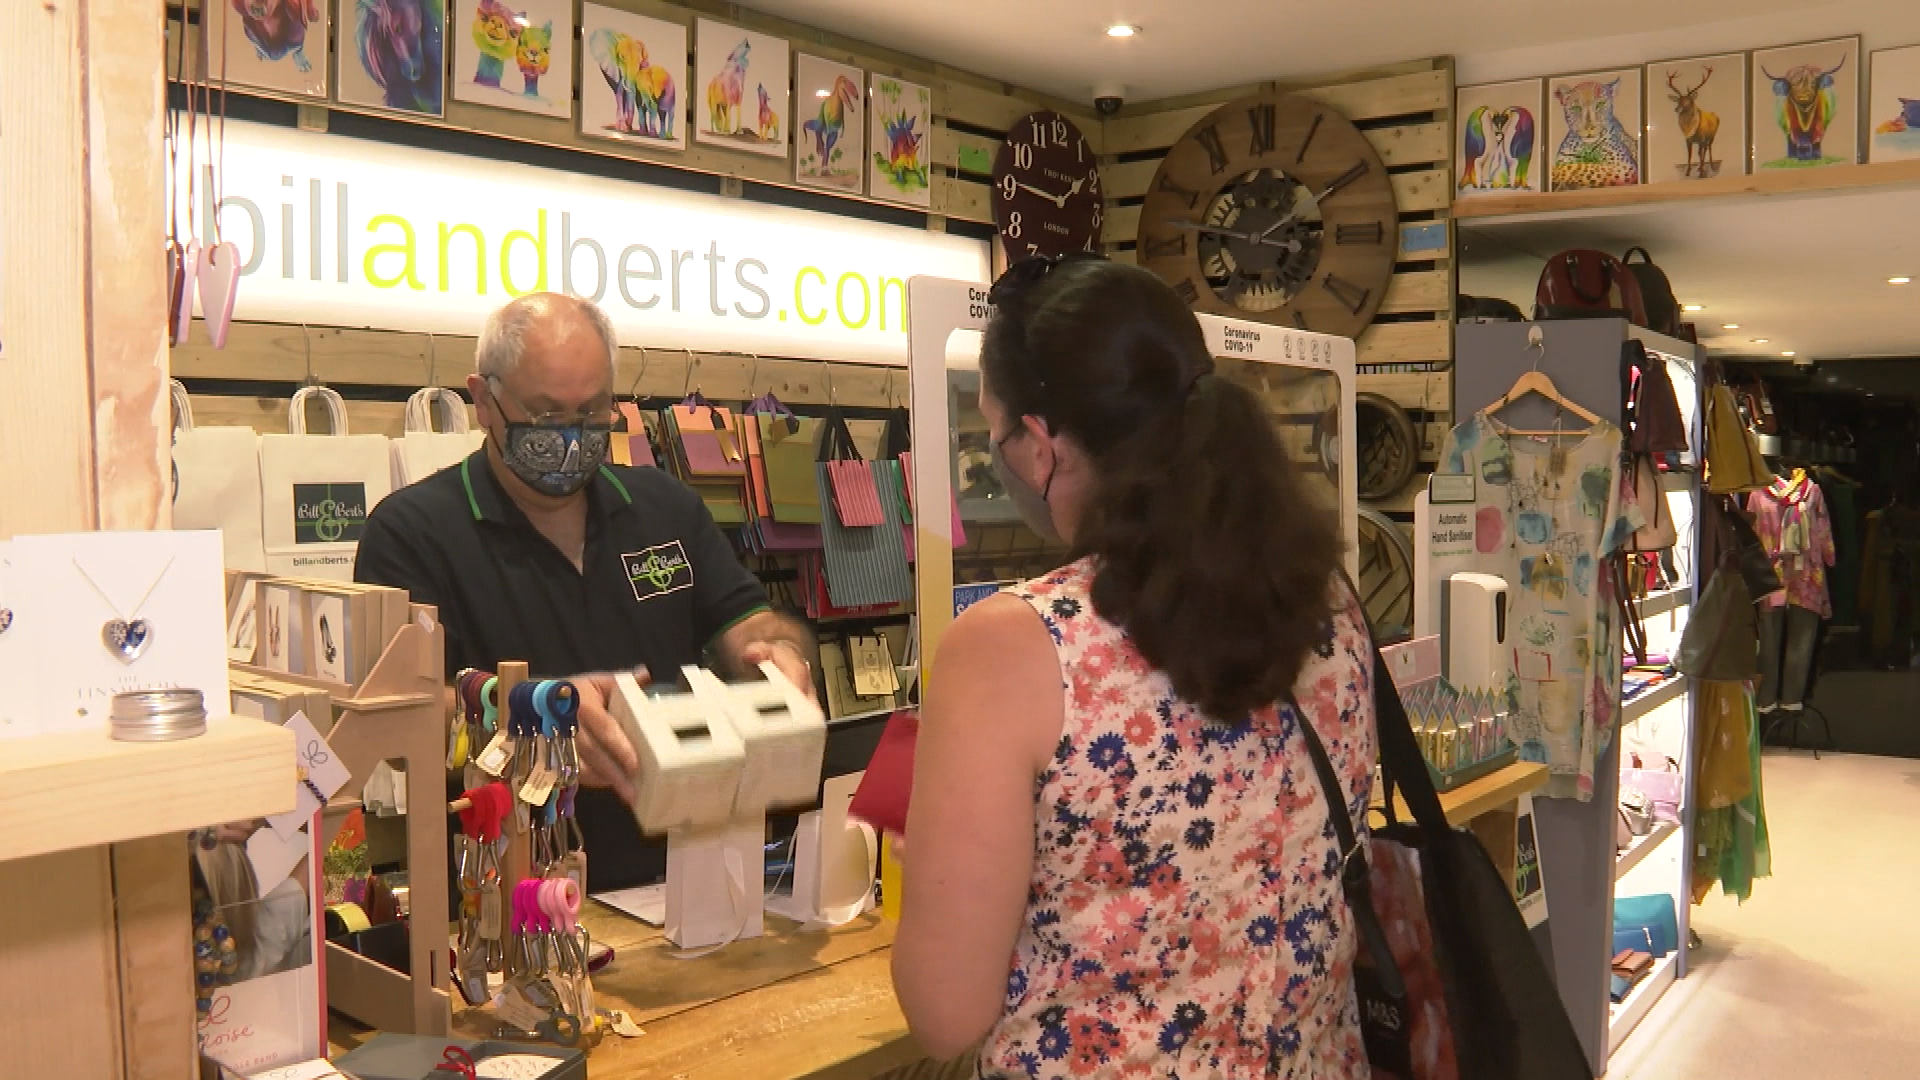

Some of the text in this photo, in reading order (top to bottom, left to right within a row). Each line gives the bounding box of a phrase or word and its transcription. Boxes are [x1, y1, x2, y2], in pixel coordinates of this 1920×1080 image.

[1032, 121, 1047, 148] 11
[1051, 119, 1068, 148] 12
[1013, 141, 1033, 170] 10
[1003, 174, 1017, 201] 9
[1089, 169, 1098, 195] 2
[1008, 211, 1022, 239] 8
[1043, 221, 1070, 236] LONDON
[1091, 203, 1101, 229] 3
[1224, 325, 1261, 341] Coronavirus
[1224, 339, 1254, 353] COVID-19
[1438, 513, 1468, 525] Automatic
[1432, 530, 1473, 542] Hand Sanitiser
[955, 589, 976, 604] PARK
